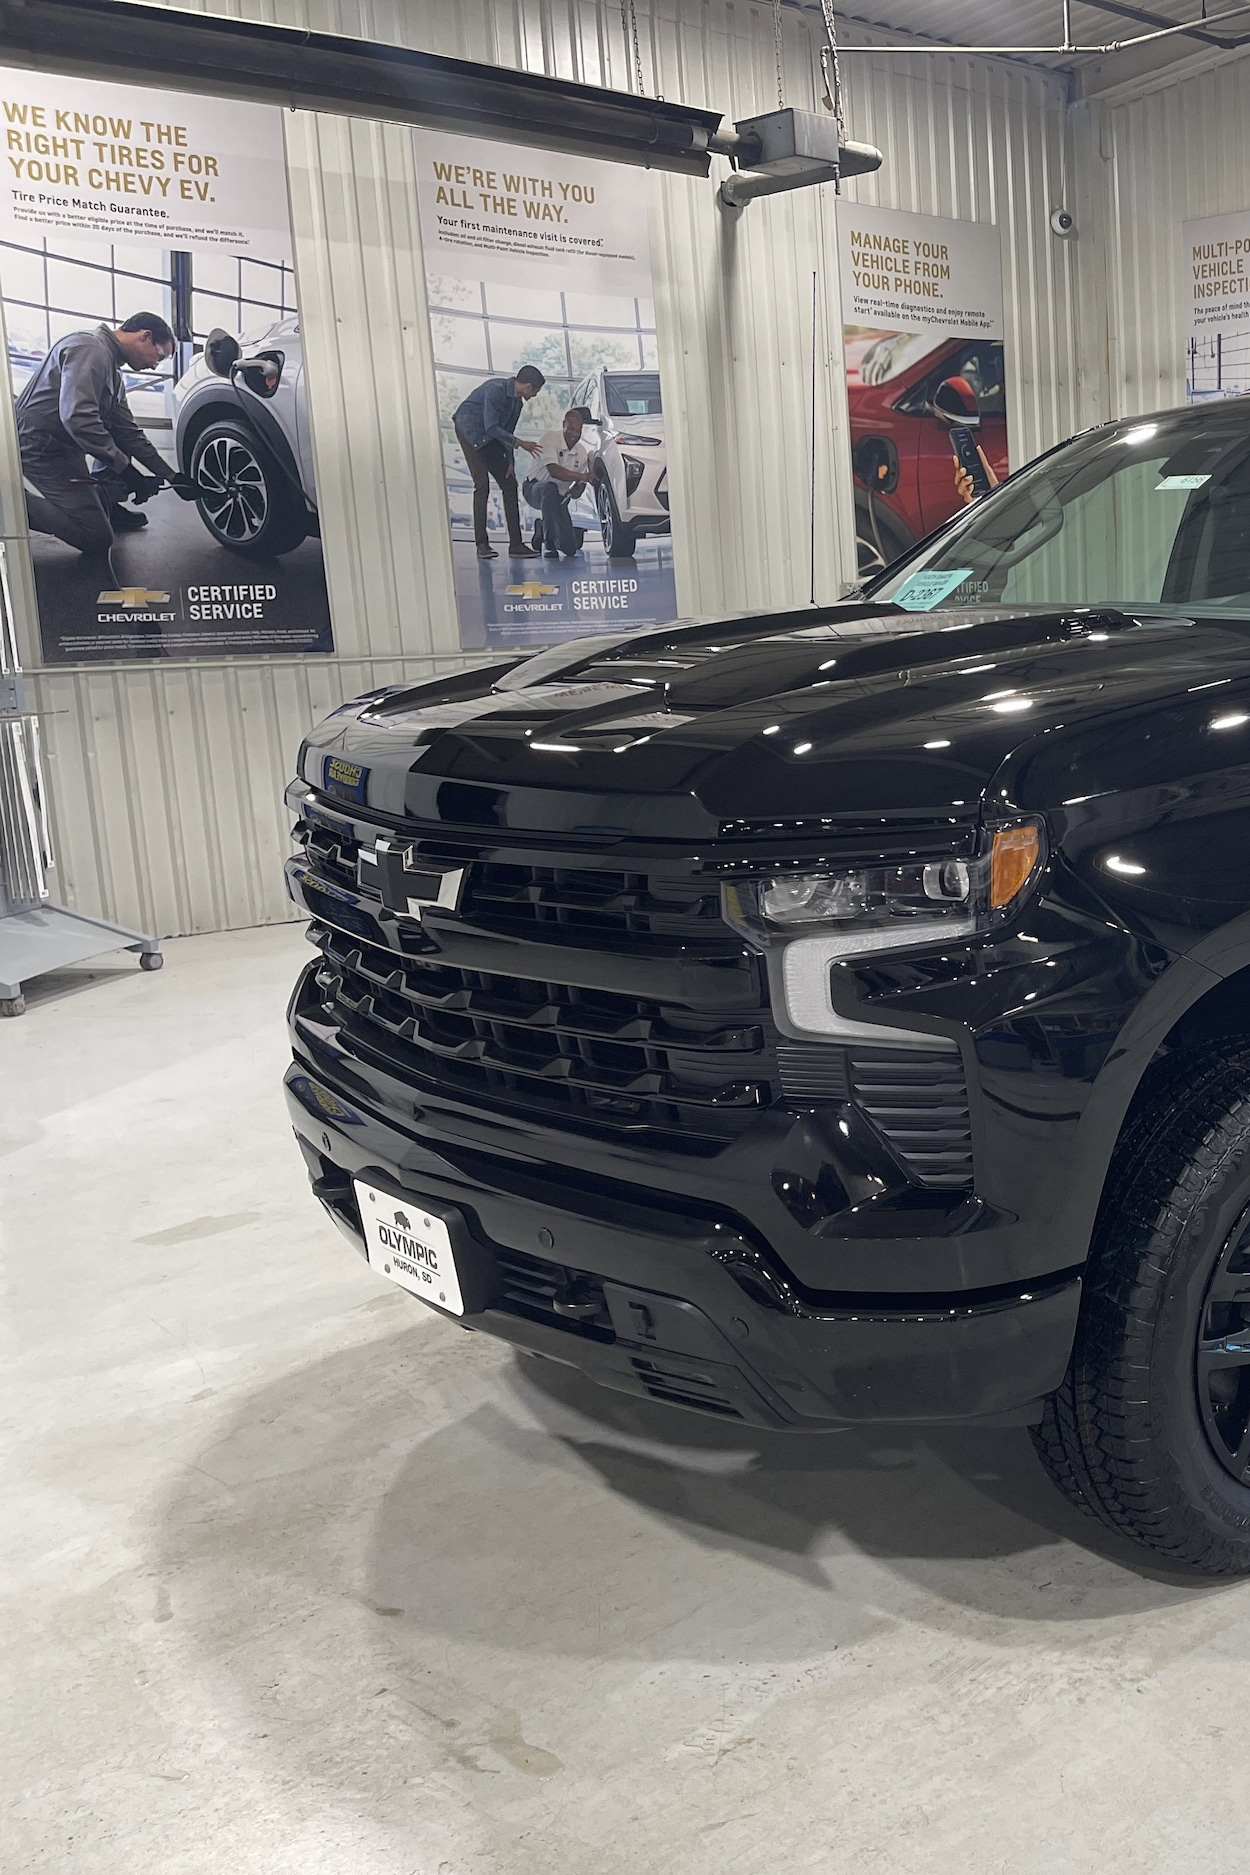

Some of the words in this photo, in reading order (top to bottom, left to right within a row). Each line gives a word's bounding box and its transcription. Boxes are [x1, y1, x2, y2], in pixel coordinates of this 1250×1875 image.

[4, 102, 47, 128] WE
[55, 109, 132, 140] KNOW
[140, 121, 188, 147] THE
[6, 129, 85, 160] RIGHT
[93, 142, 164, 170] TIRES
[174, 152, 219, 177] FOR
[8, 156, 80, 186] YOUR
[88, 167, 171, 197] CHEVY
[180, 179, 216, 202] EV.
[432, 161, 497, 190] WE'RE
[502, 173, 553, 199] WITH
[558, 182, 595, 204] YOU
[11, 189, 35, 203] Tire
[39, 194, 69, 207] Price
[72, 198, 107, 212] Match
[110, 203, 170, 218] Guarantee.
[435, 186, 474, 209] ALL
[479, 193, 518, 216] THE
[523, 200, 569, 224] WAY.
[437, 215, 458, 226] Your
[460, 219, 480, 231] first
[482, 225, 538, 239] maintenance
[540, 232, 558, 242] visit
[560, 234, 567, 243] is
[850, 230, 910, 255] MANAGE
[913, 240, 949, 260] YOUR
[851, 250, 910, 275] VEHICLE
[914, 260, 950, 280] FROM
[1193, 258, 1244, 280] VEHICLE
[853, 270, 890, 291] YOUR
[894, 277, 943, 299] PHONE.
[853, 295, 869, 304] View
[870, 297, 900, 310] real-time
[900, 302, 935, 315] diagnostics
[936, 306, 947, 315] and
[948, 308, 964, 318] enjoy
[964, 310, 986, 318] remote
[873, 308, 901, 319] available
[910, 312, 921, 322] the
[921, 315, 959, 326] myChevrolet
[960, 318, 979, 327] Mobile
[1193, 307, 1204, 315] The
[1204, 305, 1221, 316] peace
[1222, 303, 1228, 312] of
[1229, 301, 1243, 311] mind
[1193, 317, 1206, 326] your
[1207, 312, 1231, 323] vehicle's
[1231, 309, 1250, 320] health
[187, 584, 277, 602] CERTIFIED
[572, 579, 638, 595] CERTIFIED
[97, 612, 176, 623] CHEVROLET
[189, 603, 264, 621] SERVICE
[503, 603, 564, 613] CHEVROLET
[573, 595, 628, 610] SERVICE
[378, 1225, 438, 1270] OLYMPIC
[393, 1256, 421, 1280] HURON,
[421, 1271, 433, 1284] SD
